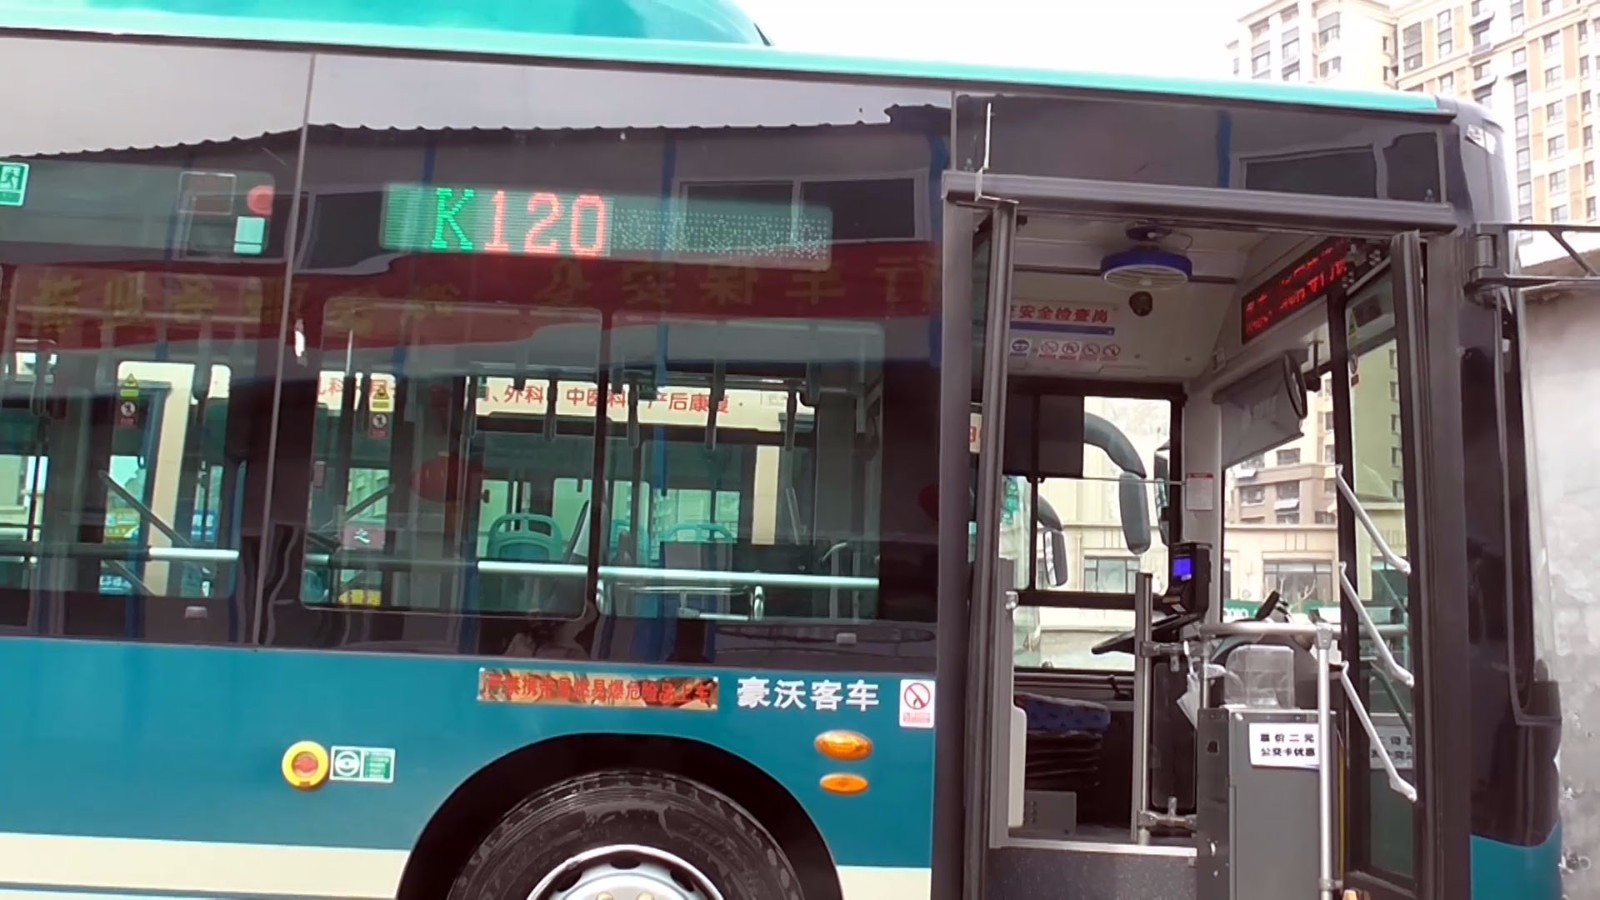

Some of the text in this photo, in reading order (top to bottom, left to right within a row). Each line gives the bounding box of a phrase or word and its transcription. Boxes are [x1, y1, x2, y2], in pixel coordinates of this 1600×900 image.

[430, 186, 607, 257] K120
[736, 675, 880, 711] 豪沃客车
